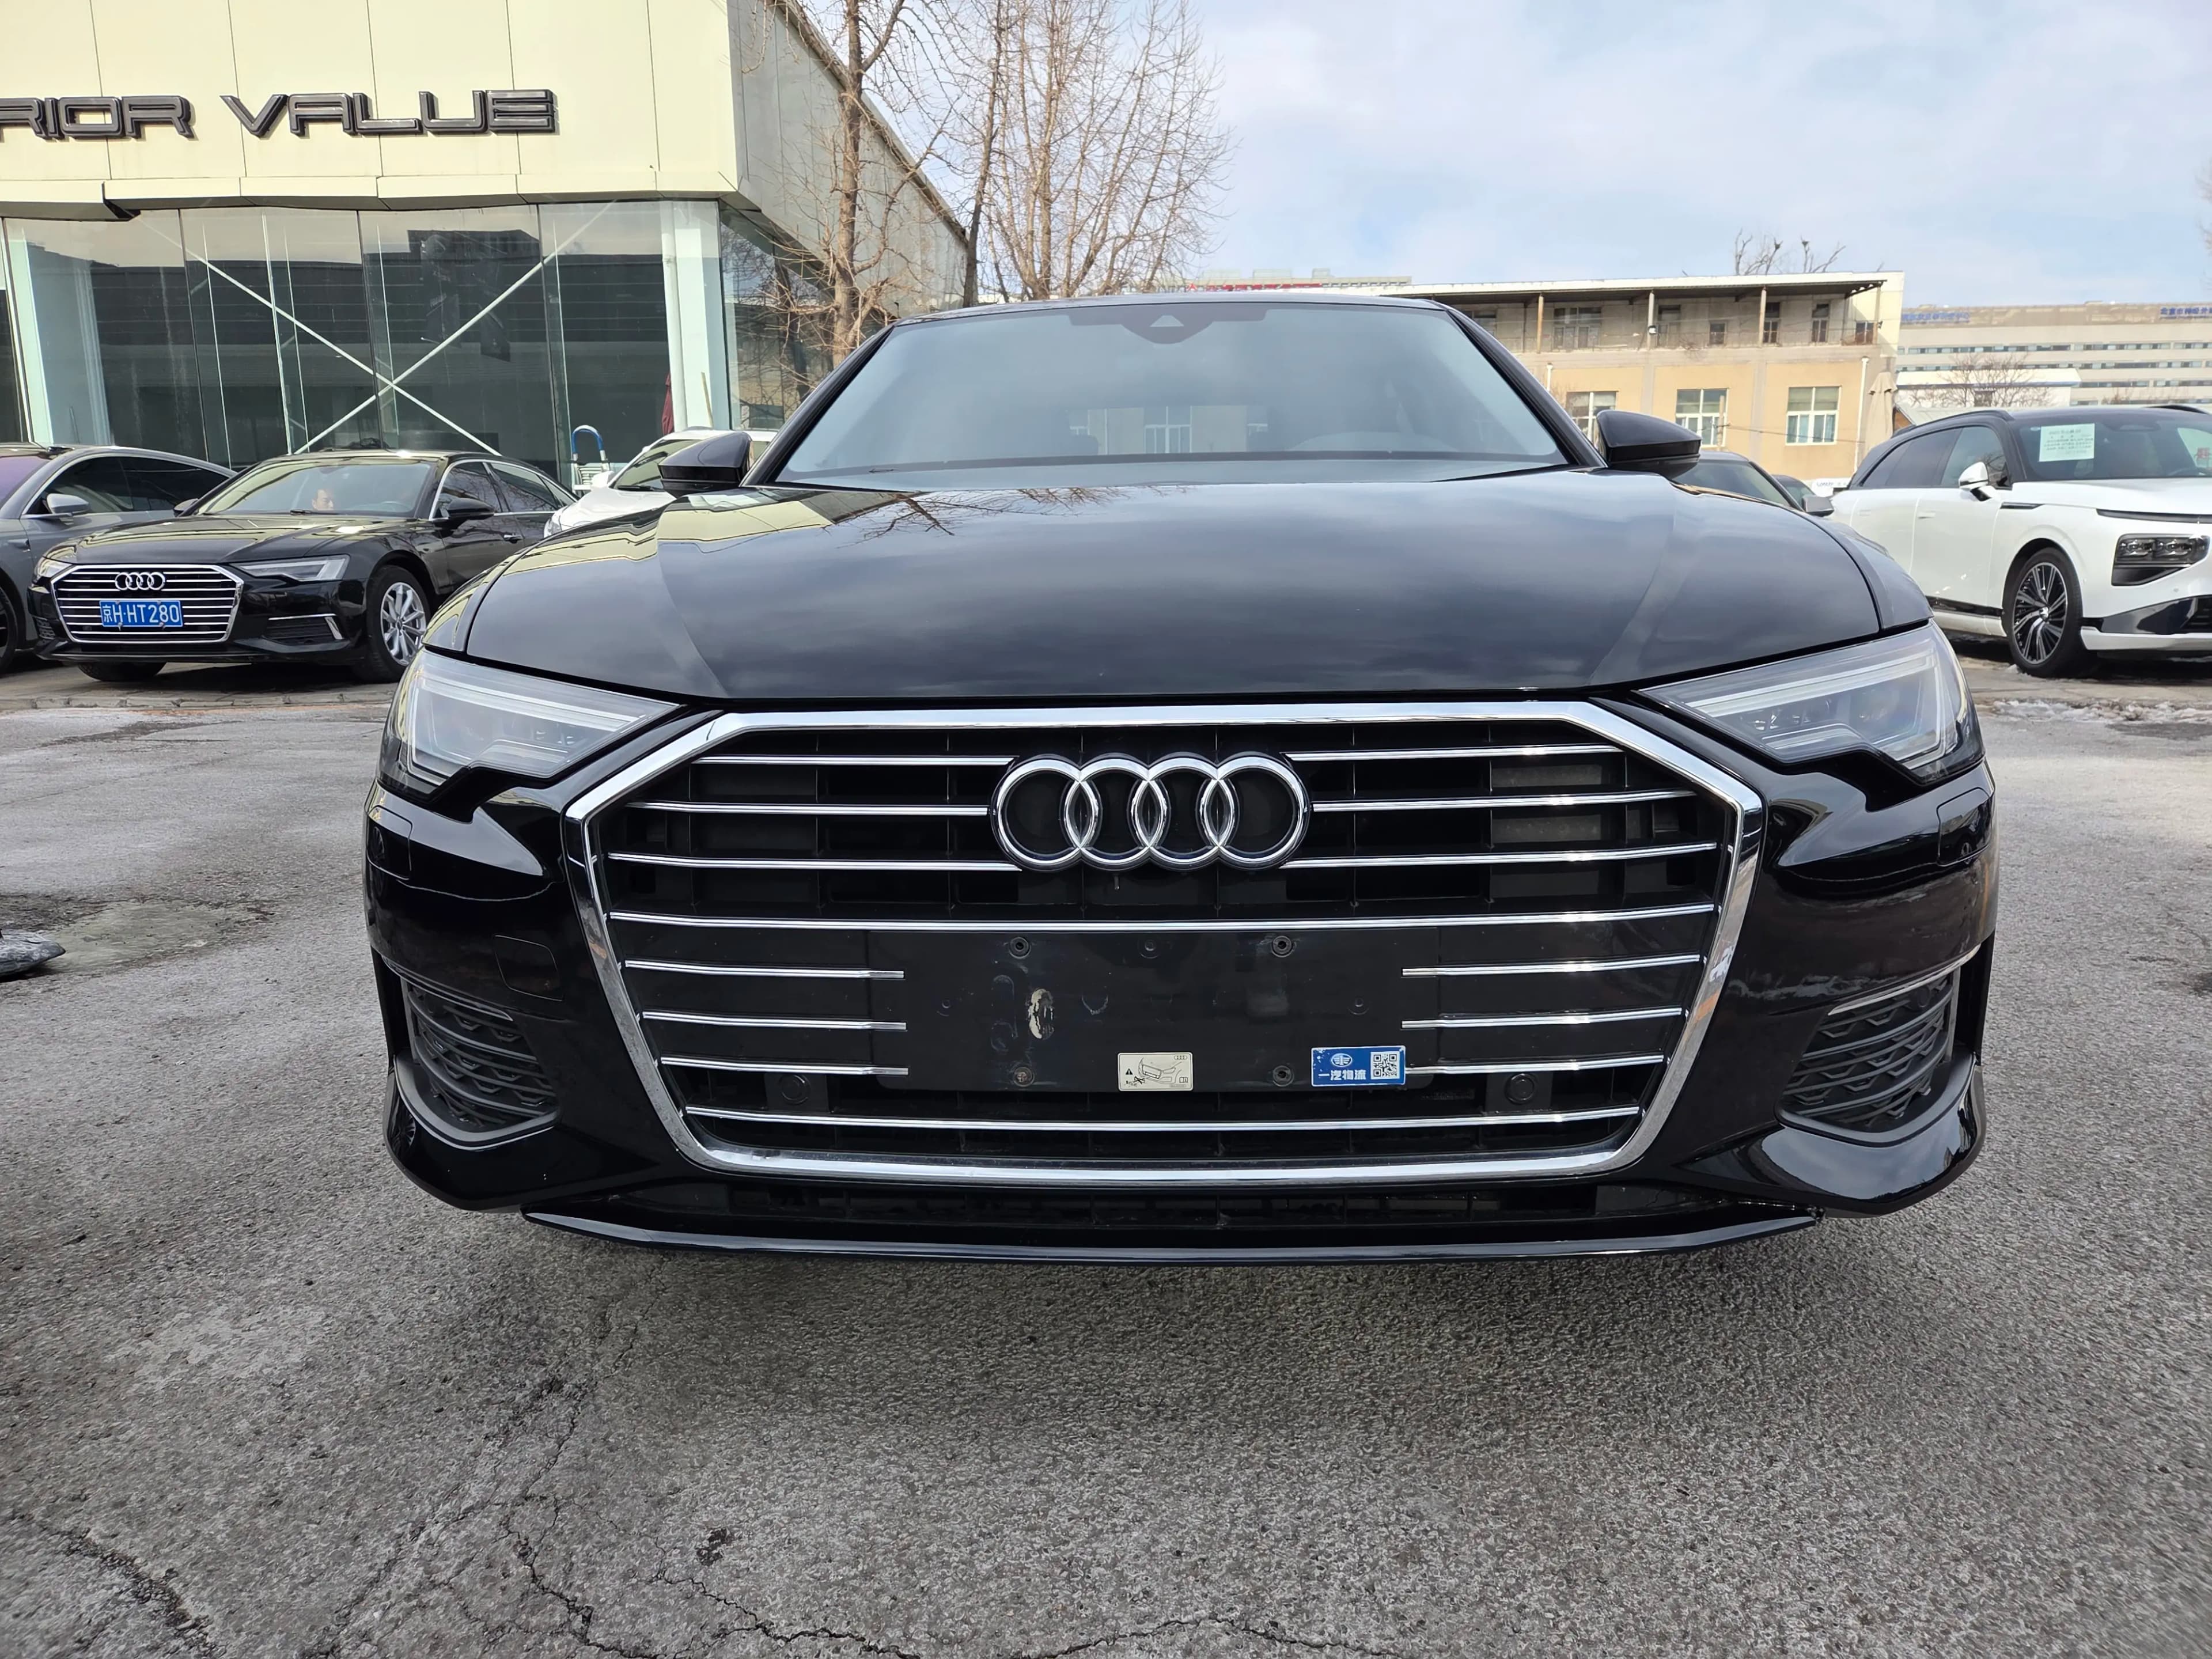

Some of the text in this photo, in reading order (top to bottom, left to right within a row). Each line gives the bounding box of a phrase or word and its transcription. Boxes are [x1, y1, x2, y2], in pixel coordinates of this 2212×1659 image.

[0, 89, 556, 139] RIOR VALUE
[1318, 1069, 1366, 1081] 一汽物流
